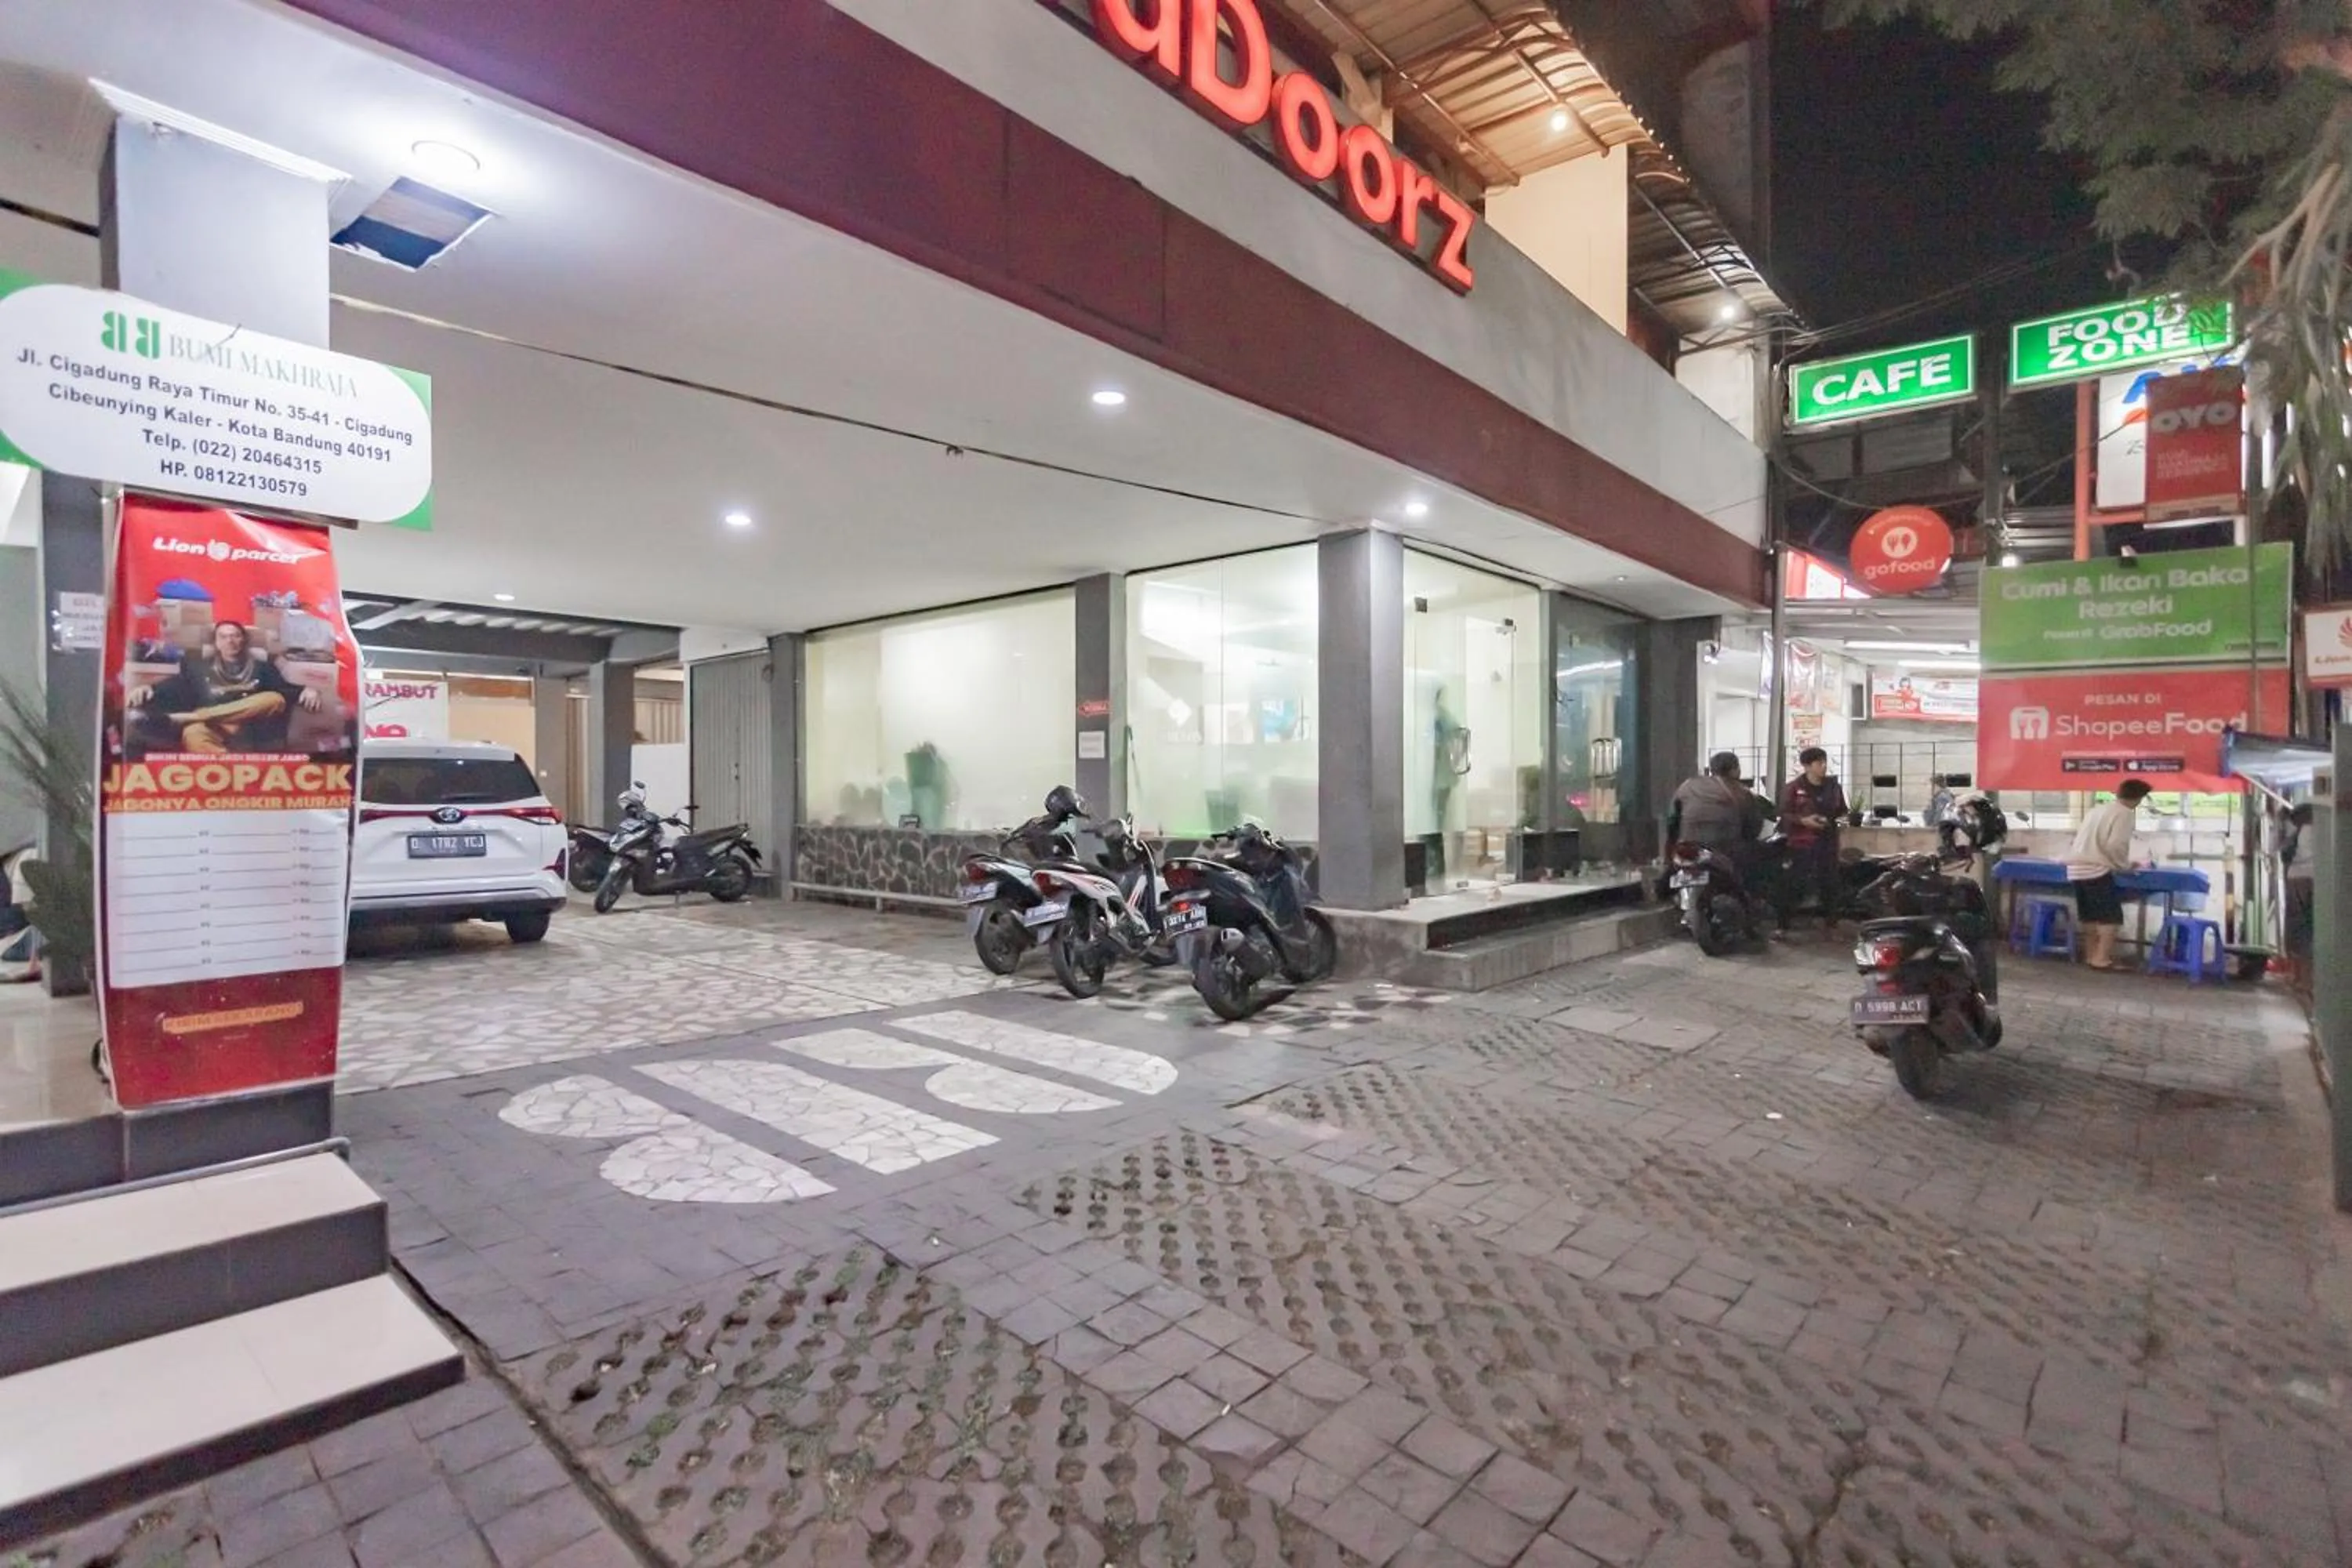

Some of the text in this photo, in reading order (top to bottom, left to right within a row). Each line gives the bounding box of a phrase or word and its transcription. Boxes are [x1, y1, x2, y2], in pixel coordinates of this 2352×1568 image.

[2048, 303, 2187, 347] FOOD
[169, 334, 232, 368] BUMI
[2047, 324, 2190, 369] ZONE
[1813, 354, 1951, 405] CAFE
[17, 349, 42, 365] Jl.
[49, 354, 142, 390] Cigadung
[148, 375, 193, 398] Raya
[199, 385, 249, 408] Timur
[255, 398, 281, 416] No.
[288, 405, 329, 426] 35-41
[345, 417, 412, 445] Cigadung
[49, 383, 157, 421] Cibeunying
[164, 406, 212, 427] Kaler
[228, 419, 267, 438] Kota
[274, 427, 342, 456] Bandung
[347, 442, 390, 462] 40191
[2151, 401, 2238, 433] OYO
[142, 429, 322, 474] Telp. (022) 20464315
[160, 459, 307, 496] HP. 08122130579
[153, 536, 205, 555] Lion
[1864, 557, 1935, 580] gofood
[2002, 565, 2264, 600] Cumi & Ikan Baka
[2079, 594, 2173, 619] Rezeki
[2099, 619, 2212, 639] GrabFood
[2085, 693, 2161, 706] PESAN DI
[2056, 711, 2248, 741] ShopeeFood
[103, 763, 352, 793] JAGOPACK
[104, 797, 198, 812] JAGONYA
[205, 796, 281, 810] ONGKIR
